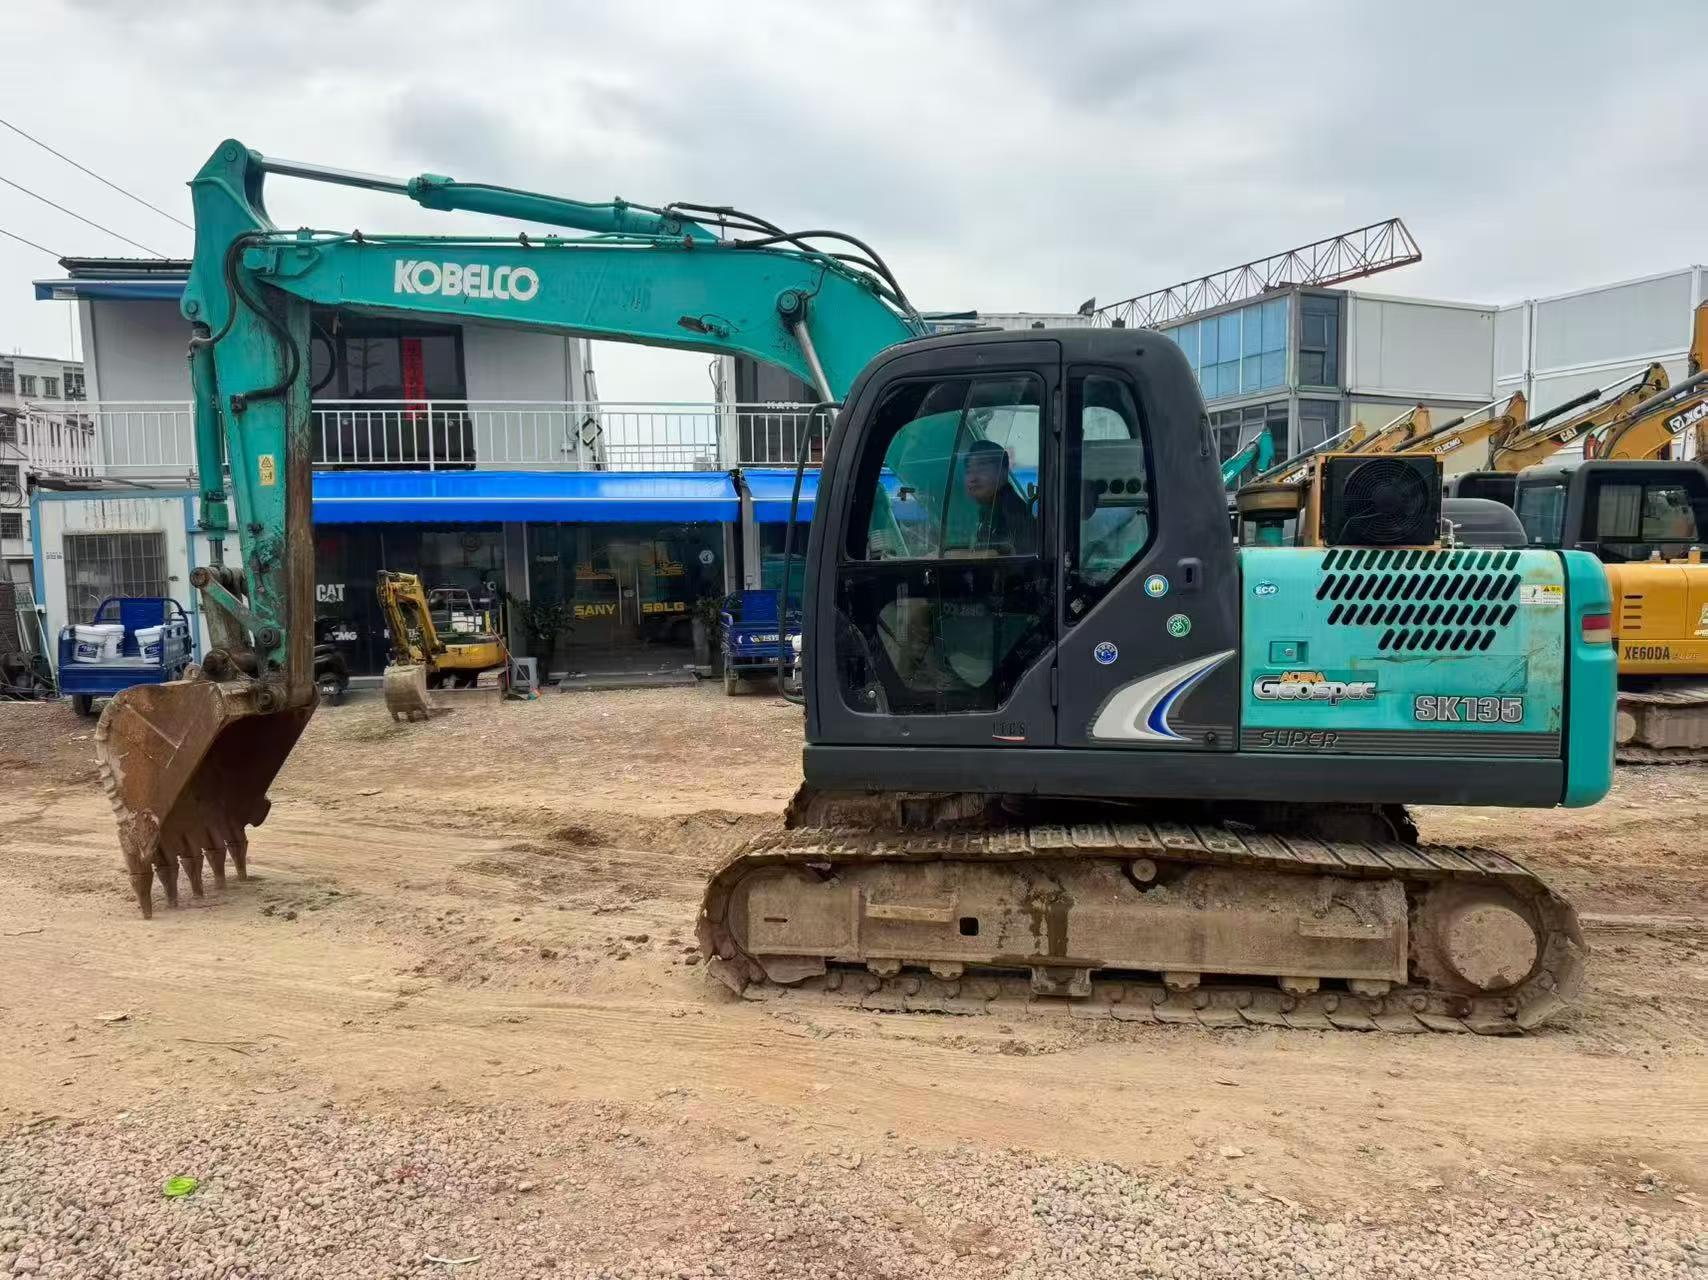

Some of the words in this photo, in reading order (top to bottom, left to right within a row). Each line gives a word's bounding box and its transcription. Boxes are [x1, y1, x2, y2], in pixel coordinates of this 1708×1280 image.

[394, 259, 540, 301] KOBELCO
[1559, 427, 1578, 443] CAT
[316, 583, 345, 603] CAT
[1255, 584, 1276, 595] ECO
[573, 604, 616, 616] SANY
[1624, 646, 1670, 660] XE60DA
[1414, 694, 1524, 723] SK135
[1259, 730, 1339, 749] SUPER
